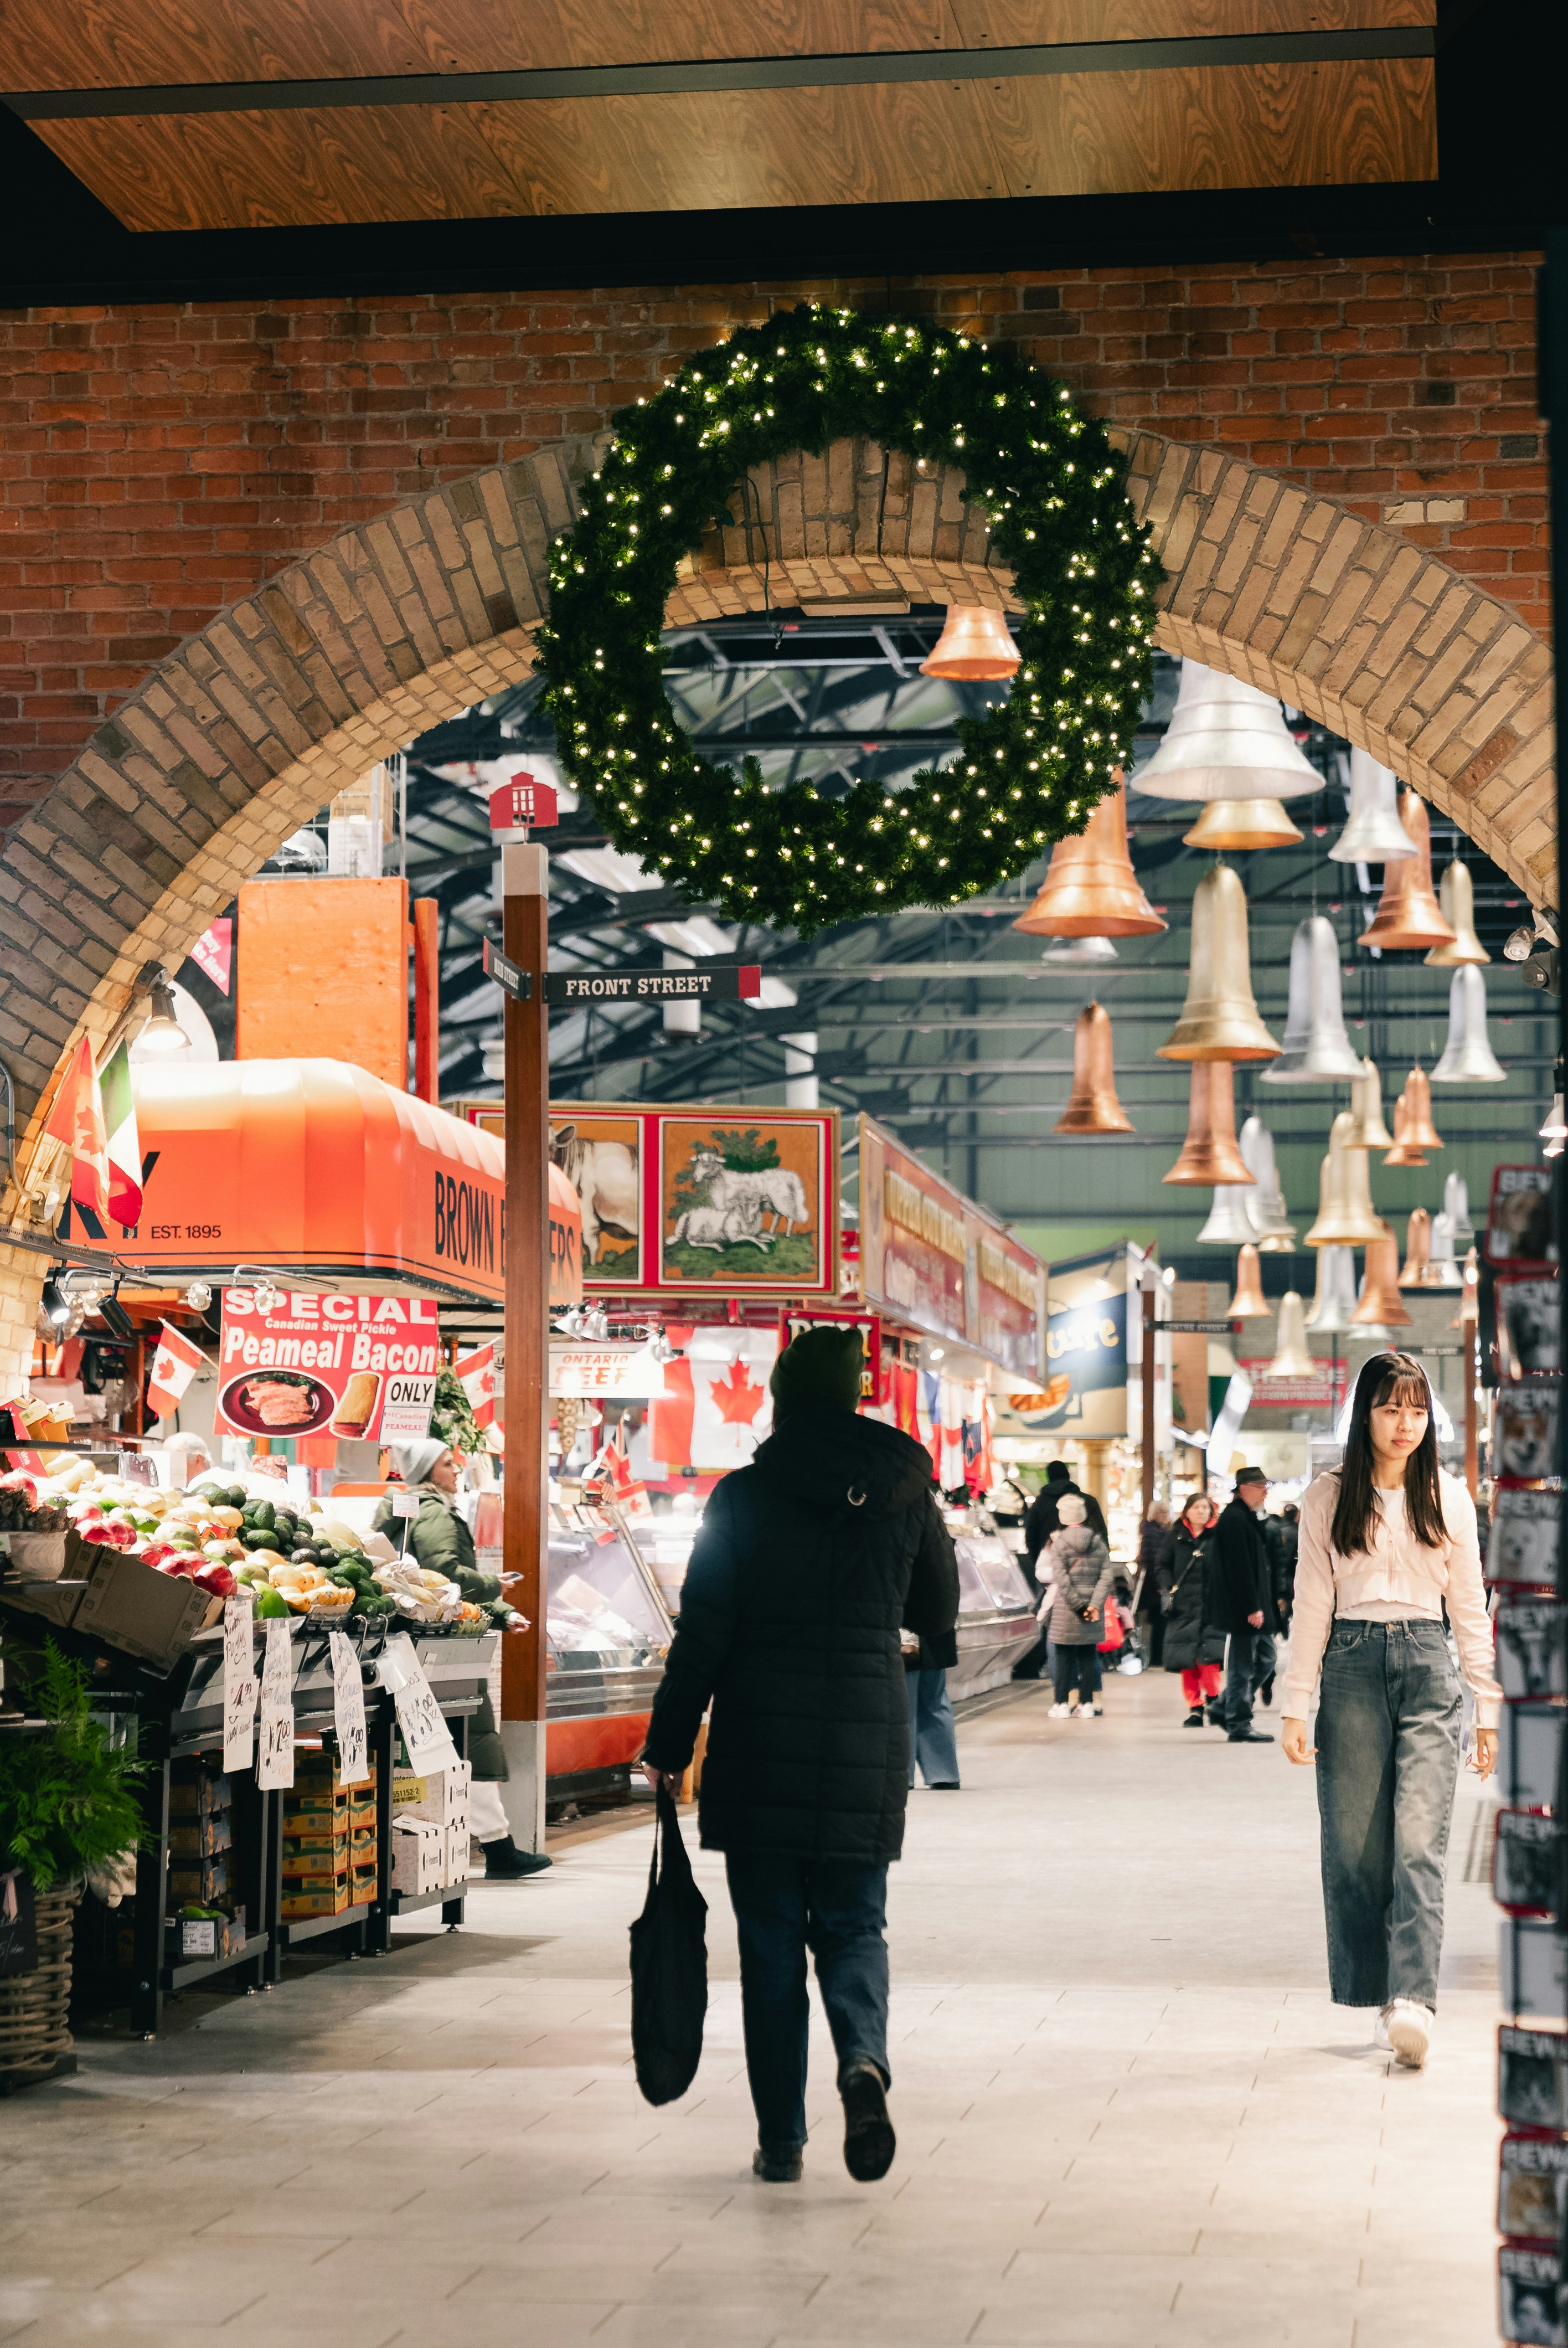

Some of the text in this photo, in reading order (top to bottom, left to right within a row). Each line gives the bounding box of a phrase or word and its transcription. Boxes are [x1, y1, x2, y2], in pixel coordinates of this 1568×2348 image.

[203, 955, 228, 983] Here
[565, 976, 711, 996] FRONT STREET
[151, 1225, 222, 1239] EST. 1895
[435, 1171, 494, 1274] BROWN
[224, 1289, 436, 1325] SPECIAL
[265, 1317, 396, 1335] Canadian Sweet Pickle
[224, 1327, 436, 1373] Peameal Bacon
[562, 1355, 629, 1364] ONTARIO
[390, 1382, 433, 1403] ONLY
